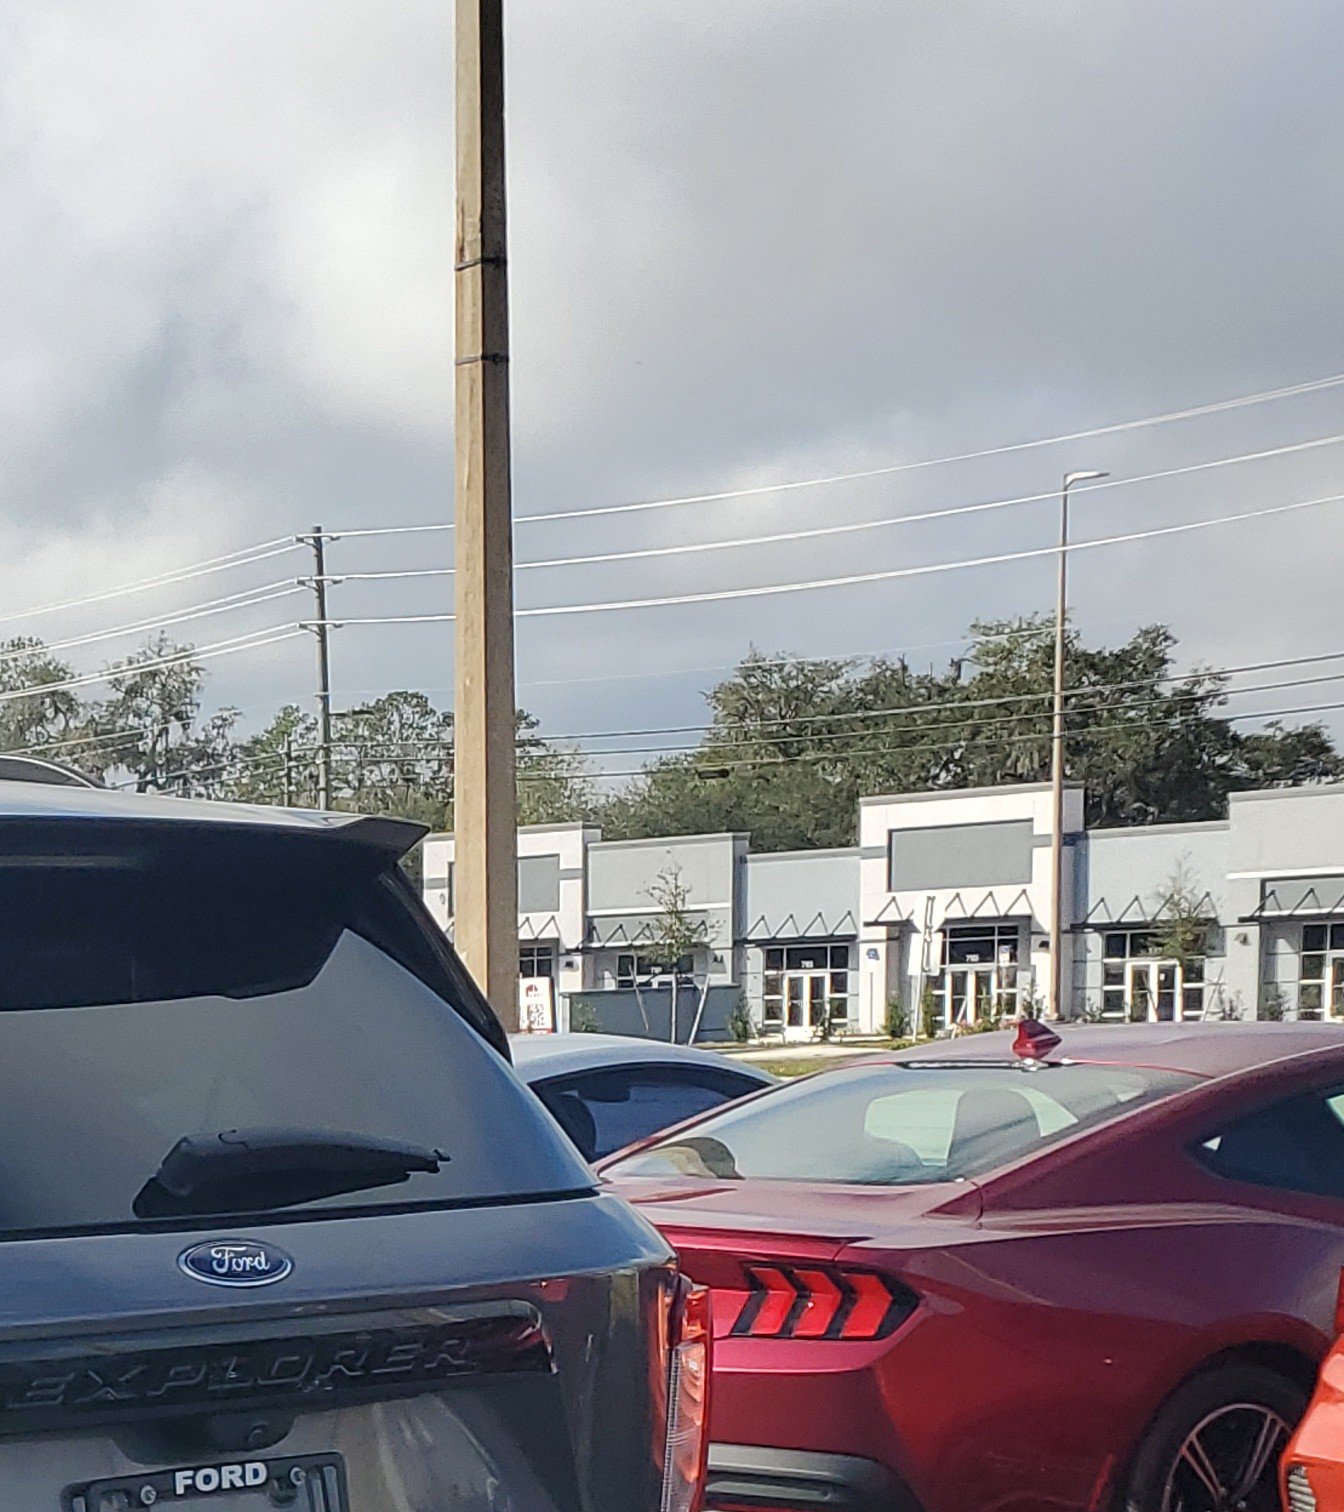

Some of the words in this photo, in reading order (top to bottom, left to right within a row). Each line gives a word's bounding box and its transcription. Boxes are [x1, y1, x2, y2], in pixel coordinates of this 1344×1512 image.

[210, 1246, 271, 1274] Ford
[11, 1338, 477, 1406] EXPLORER
[174, 1461, 268, 1496] FORD
